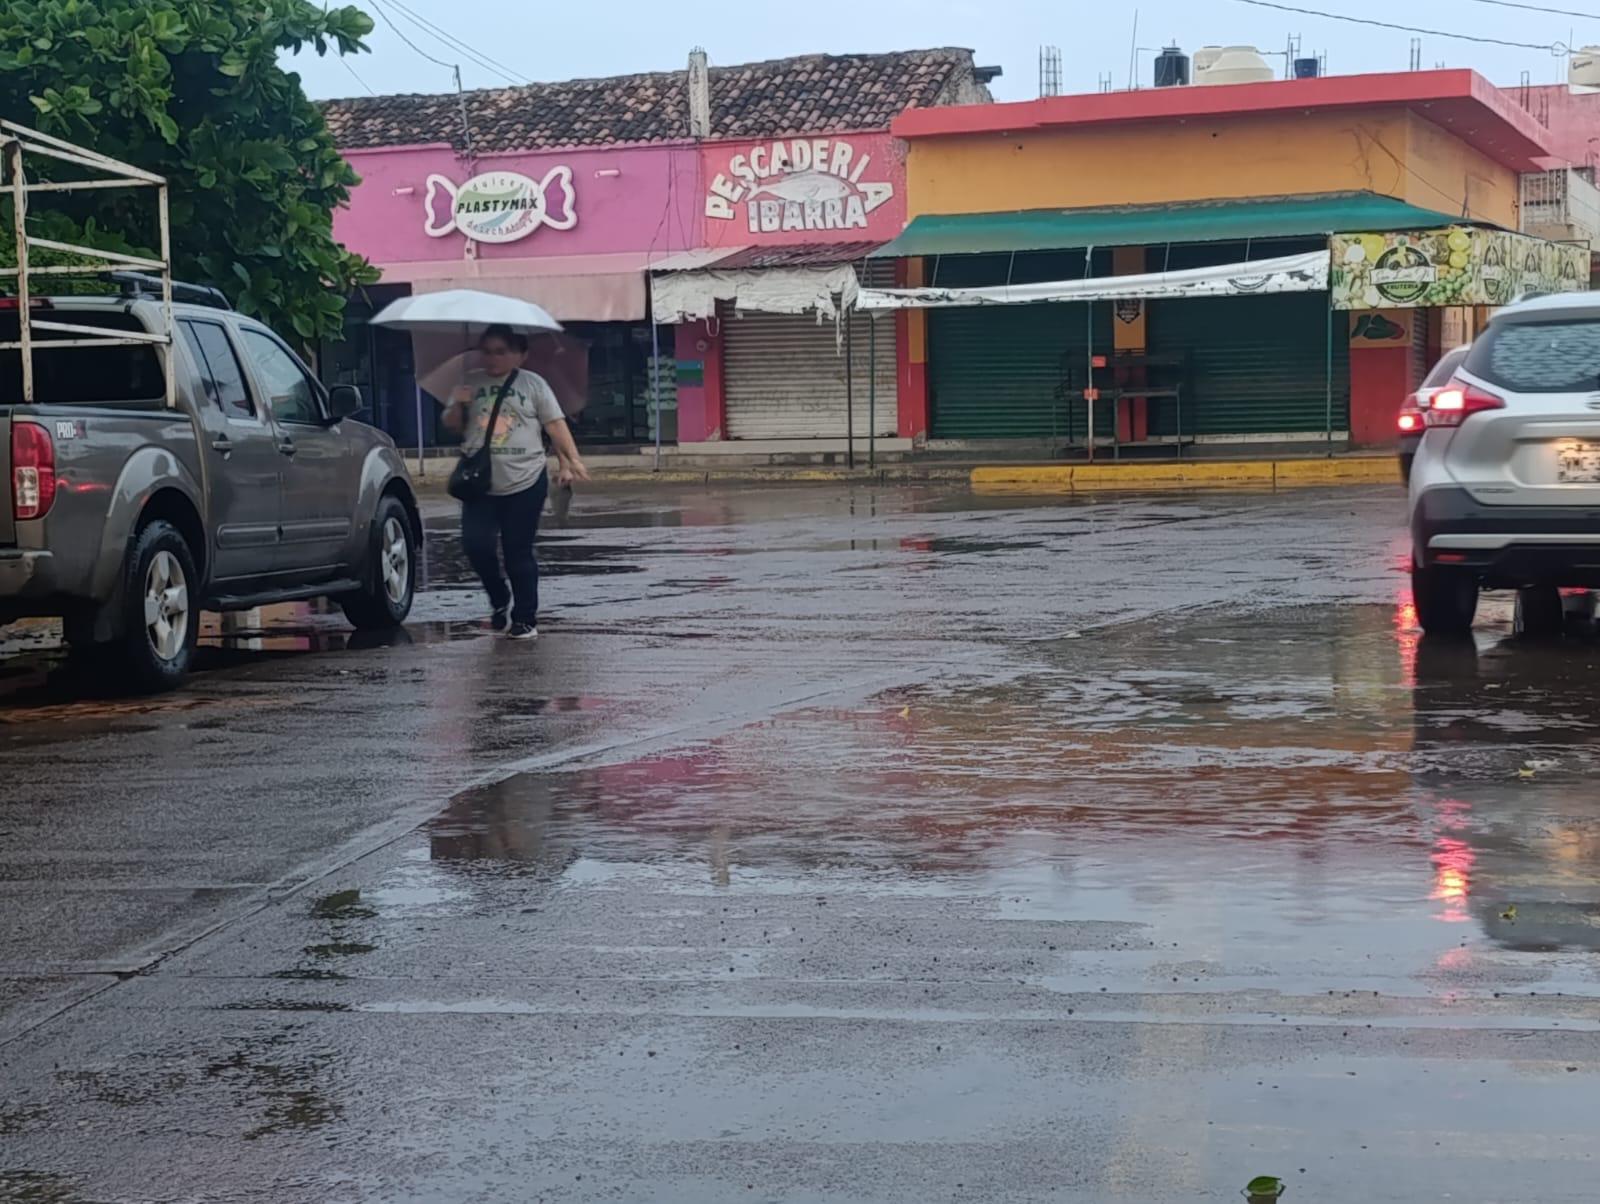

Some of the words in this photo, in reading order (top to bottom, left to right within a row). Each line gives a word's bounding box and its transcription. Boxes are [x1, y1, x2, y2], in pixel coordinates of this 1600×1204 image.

[705, 139, 894, 220] PESCADERIA
[457, 197, 539, 214] PLASTYMAX
[748, 195, 868, 233] IBARRA
